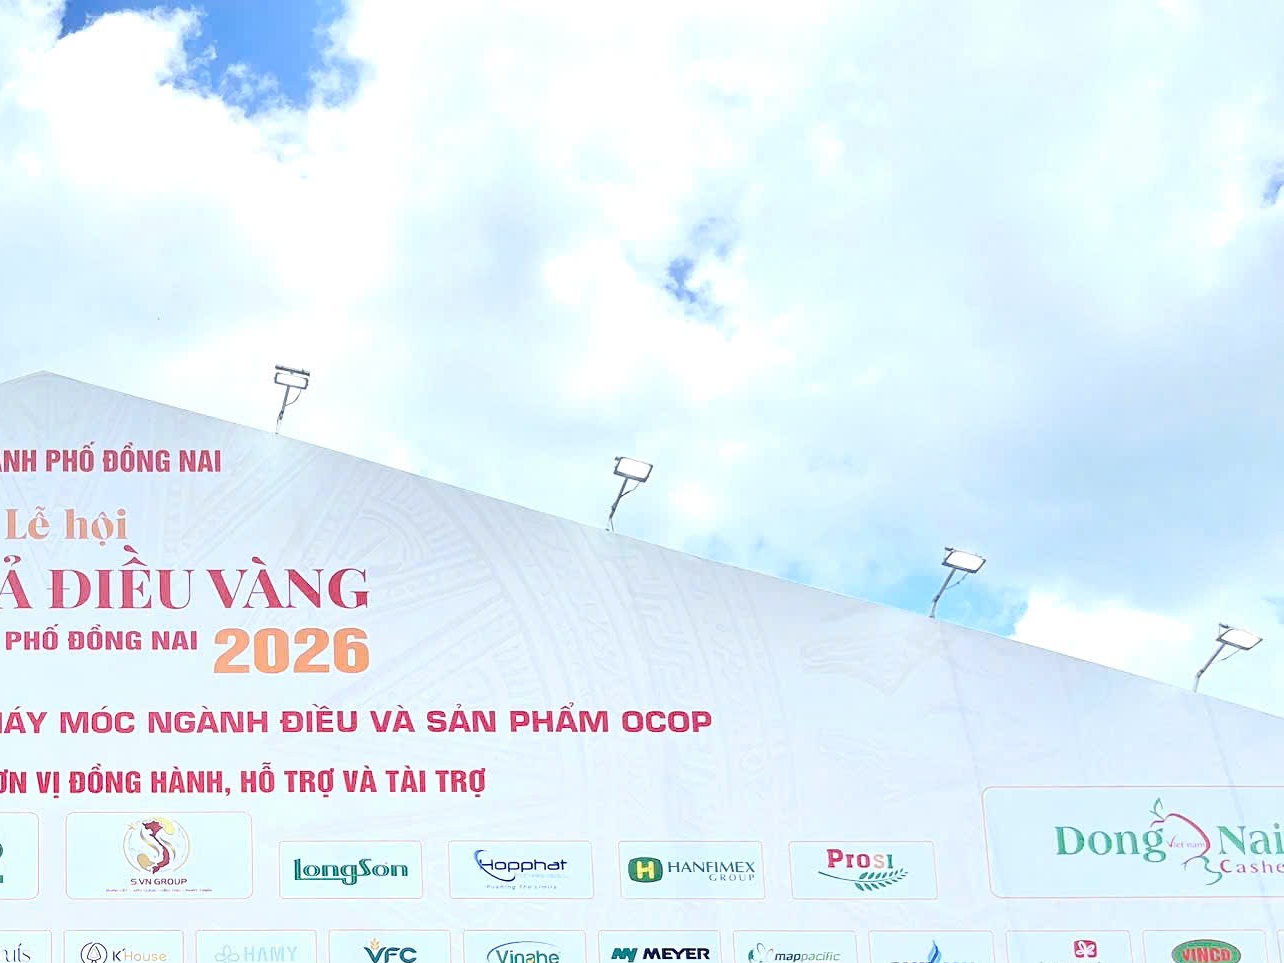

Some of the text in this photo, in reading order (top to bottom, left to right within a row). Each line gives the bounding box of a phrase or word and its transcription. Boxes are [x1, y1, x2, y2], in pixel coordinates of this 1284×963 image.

[45, 440, 96, 474] PHỐ
[102, 441, 170, 473] ĐỒNG
[175, 449, 222, 473] NAI
[5, 507, 127, 545] Lễ hội
[47, 545, 193, 610] ĐIỀU
[210, 555, 370, 610] VÀNG
[5, 622, 59, 652] PHỐ
[67, 622, 144, 651] ĐỒNG
[151, 630, 198, 651] NAI
[212, 627, 370, 674] 2026
[60, 704, 136, 734] MÓC
[148, 705, 269, 733] NGÀNH
[279, 703, 358, 733] ĐIỀU
[370, 704, 416, 733] VÀ
[426, 703, 496, 733] SẢN
[509, 702, 610, 733] PHẨM
[622, 710, 712, 733] OCOP
[33, 771, 60, 799] VỊ
[68, 763, 142, 794] ĐỒNG
[151, 764, 231, 798] HÀNH,
[240, 762, 275, 793] HỖ
[284, 769, 335, 798] TRỢ
[343, 763, 377, 792] VÀ
[385, 763, 427, 792] TÀI
[436, 769, 486, 798] TRỢ
[1054, 822, 1284, 863] Dong Nai
[479, 859, 568, 872] Hopphat
[667, 861, 756, 874] HANFIMEX
[709, 874, 756, 882] GROUP
[243, 946, 298, 962] HAMY
[364, 947, 417, 963] VFC
[642, 948, 710, 960] MEYER
[774, 952, 841, 963] mappacific
